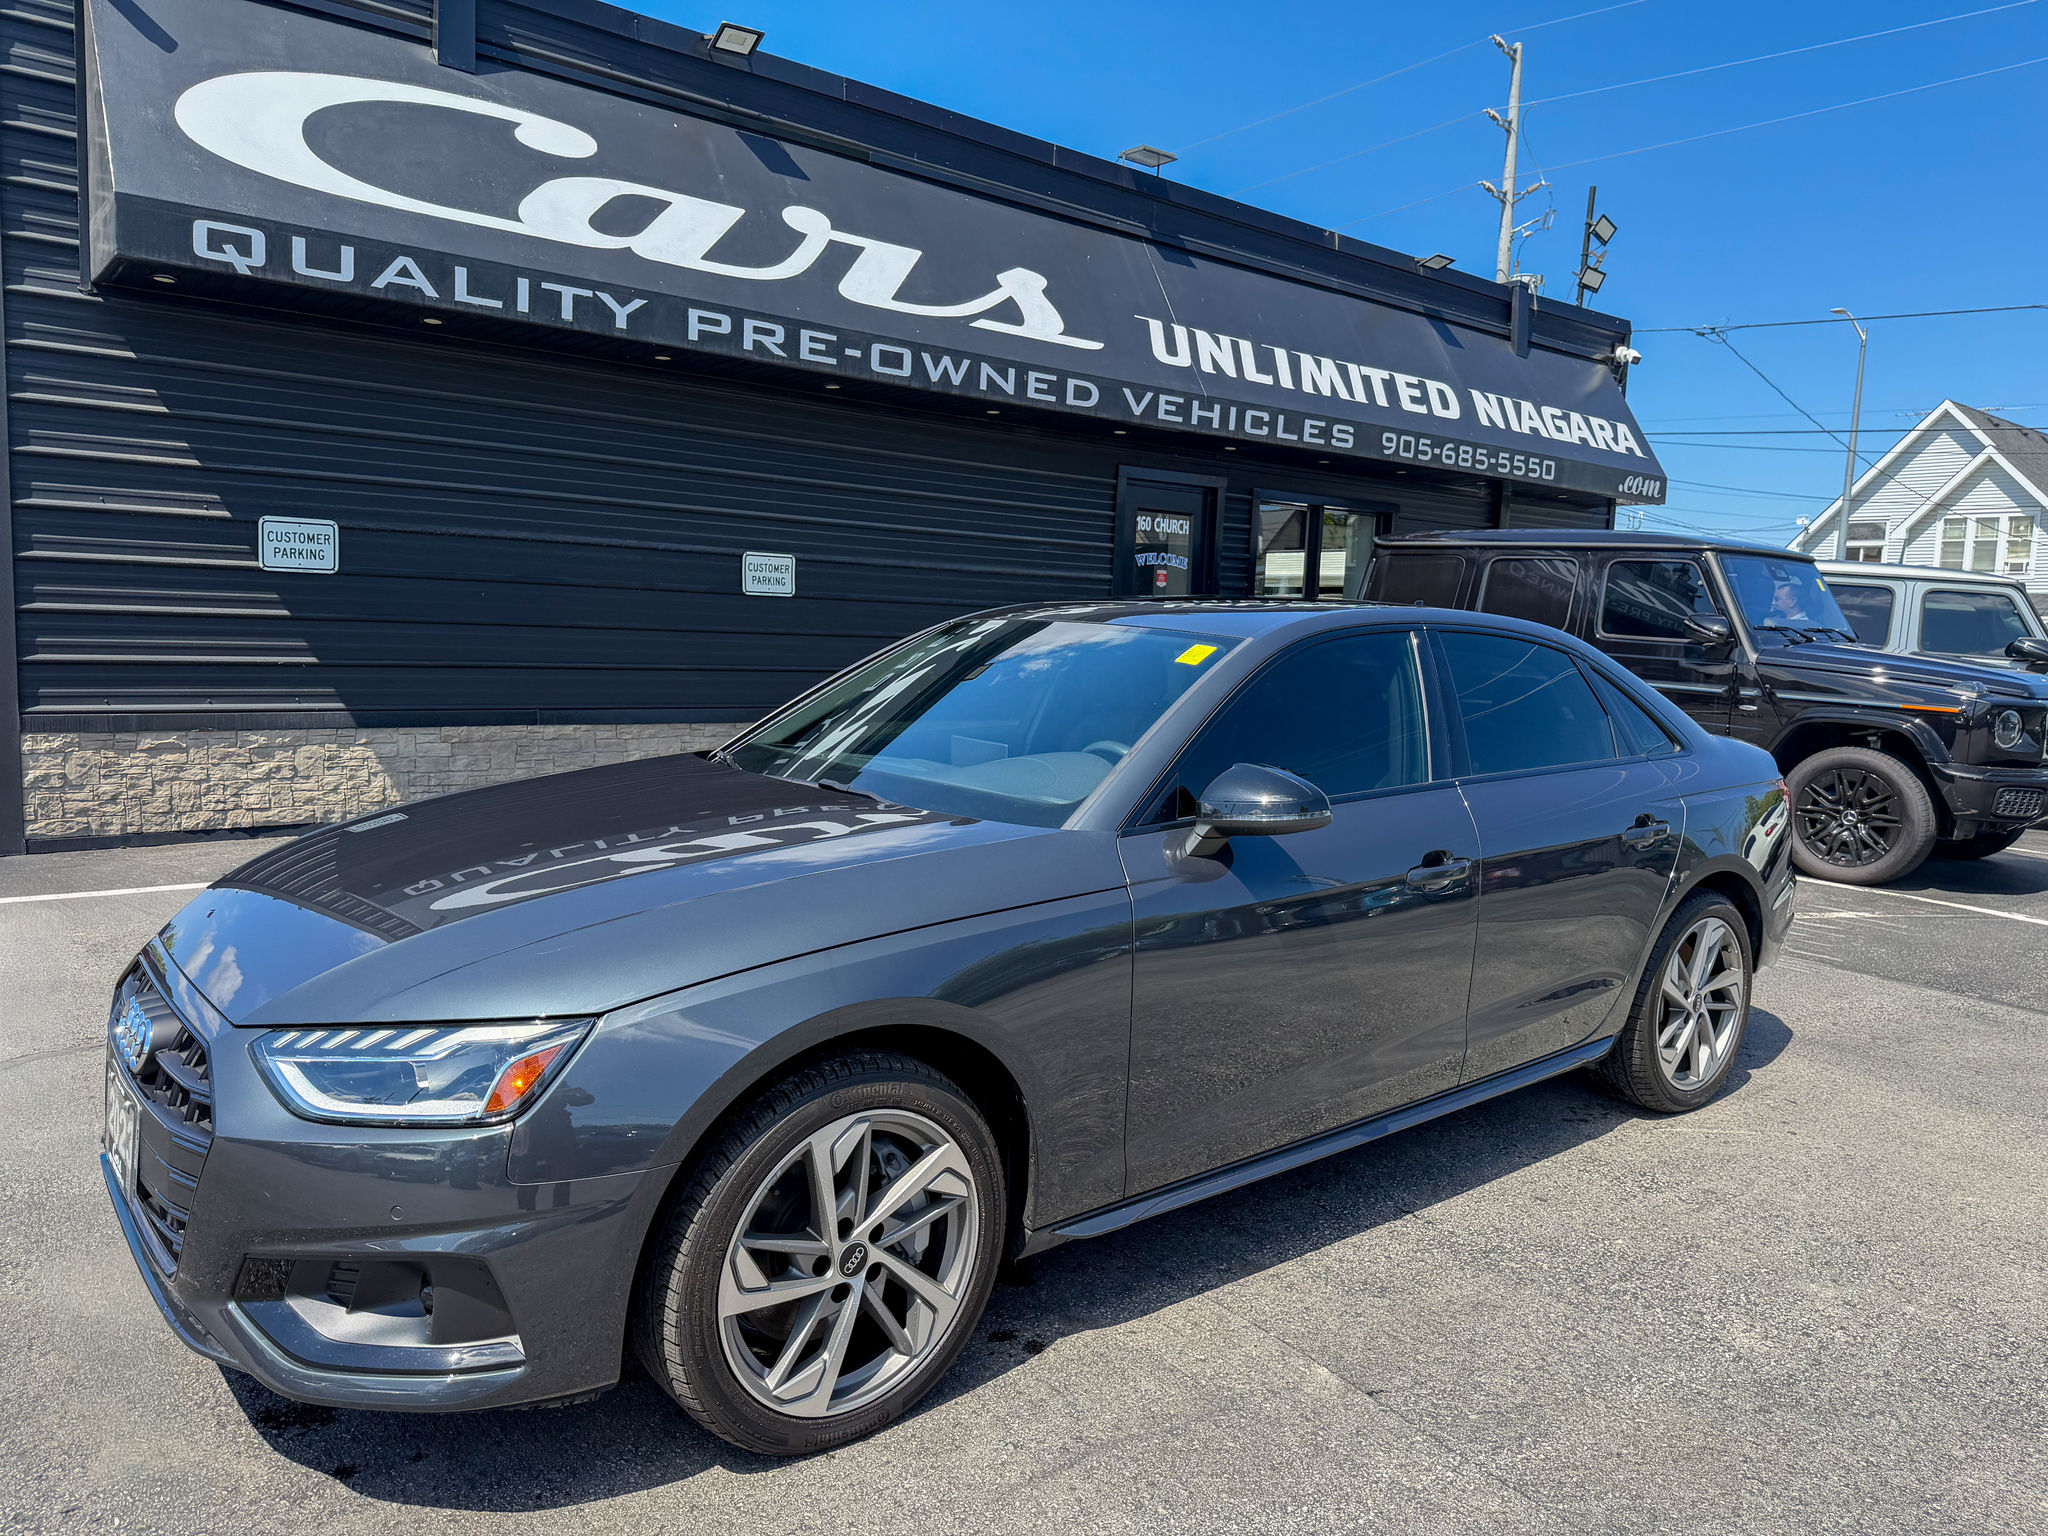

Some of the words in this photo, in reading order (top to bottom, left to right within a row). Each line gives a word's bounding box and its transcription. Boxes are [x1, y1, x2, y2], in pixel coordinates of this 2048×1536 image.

[174, 71, 1104, 350] Cars
[193, 220, 648, 329] QUALITY
[688, 308, 1099, 408] PRE-OWNED
[1123, 388, 1354, 449] VEHICLES
[1382, 433, 1555, 480] 905-685-5550
[1134, 314, 1460, 420] UNLIMITED
[1468, 389, 1648, 458] NIAGARA
[1618, 475, 1661, 498] .com
[1136, 515, 1152, 531] 160
[1154, 517, 1190, 535] CHURCH
[267, 530, 331, 545] CUSTOMER
[273, 547, 325, 560] PARKING
[1135, 552, 1189, 570] WELCOME
[747, 562, 790, 574] CUSTOMER
[752, 575, 786, 587] PARKING
